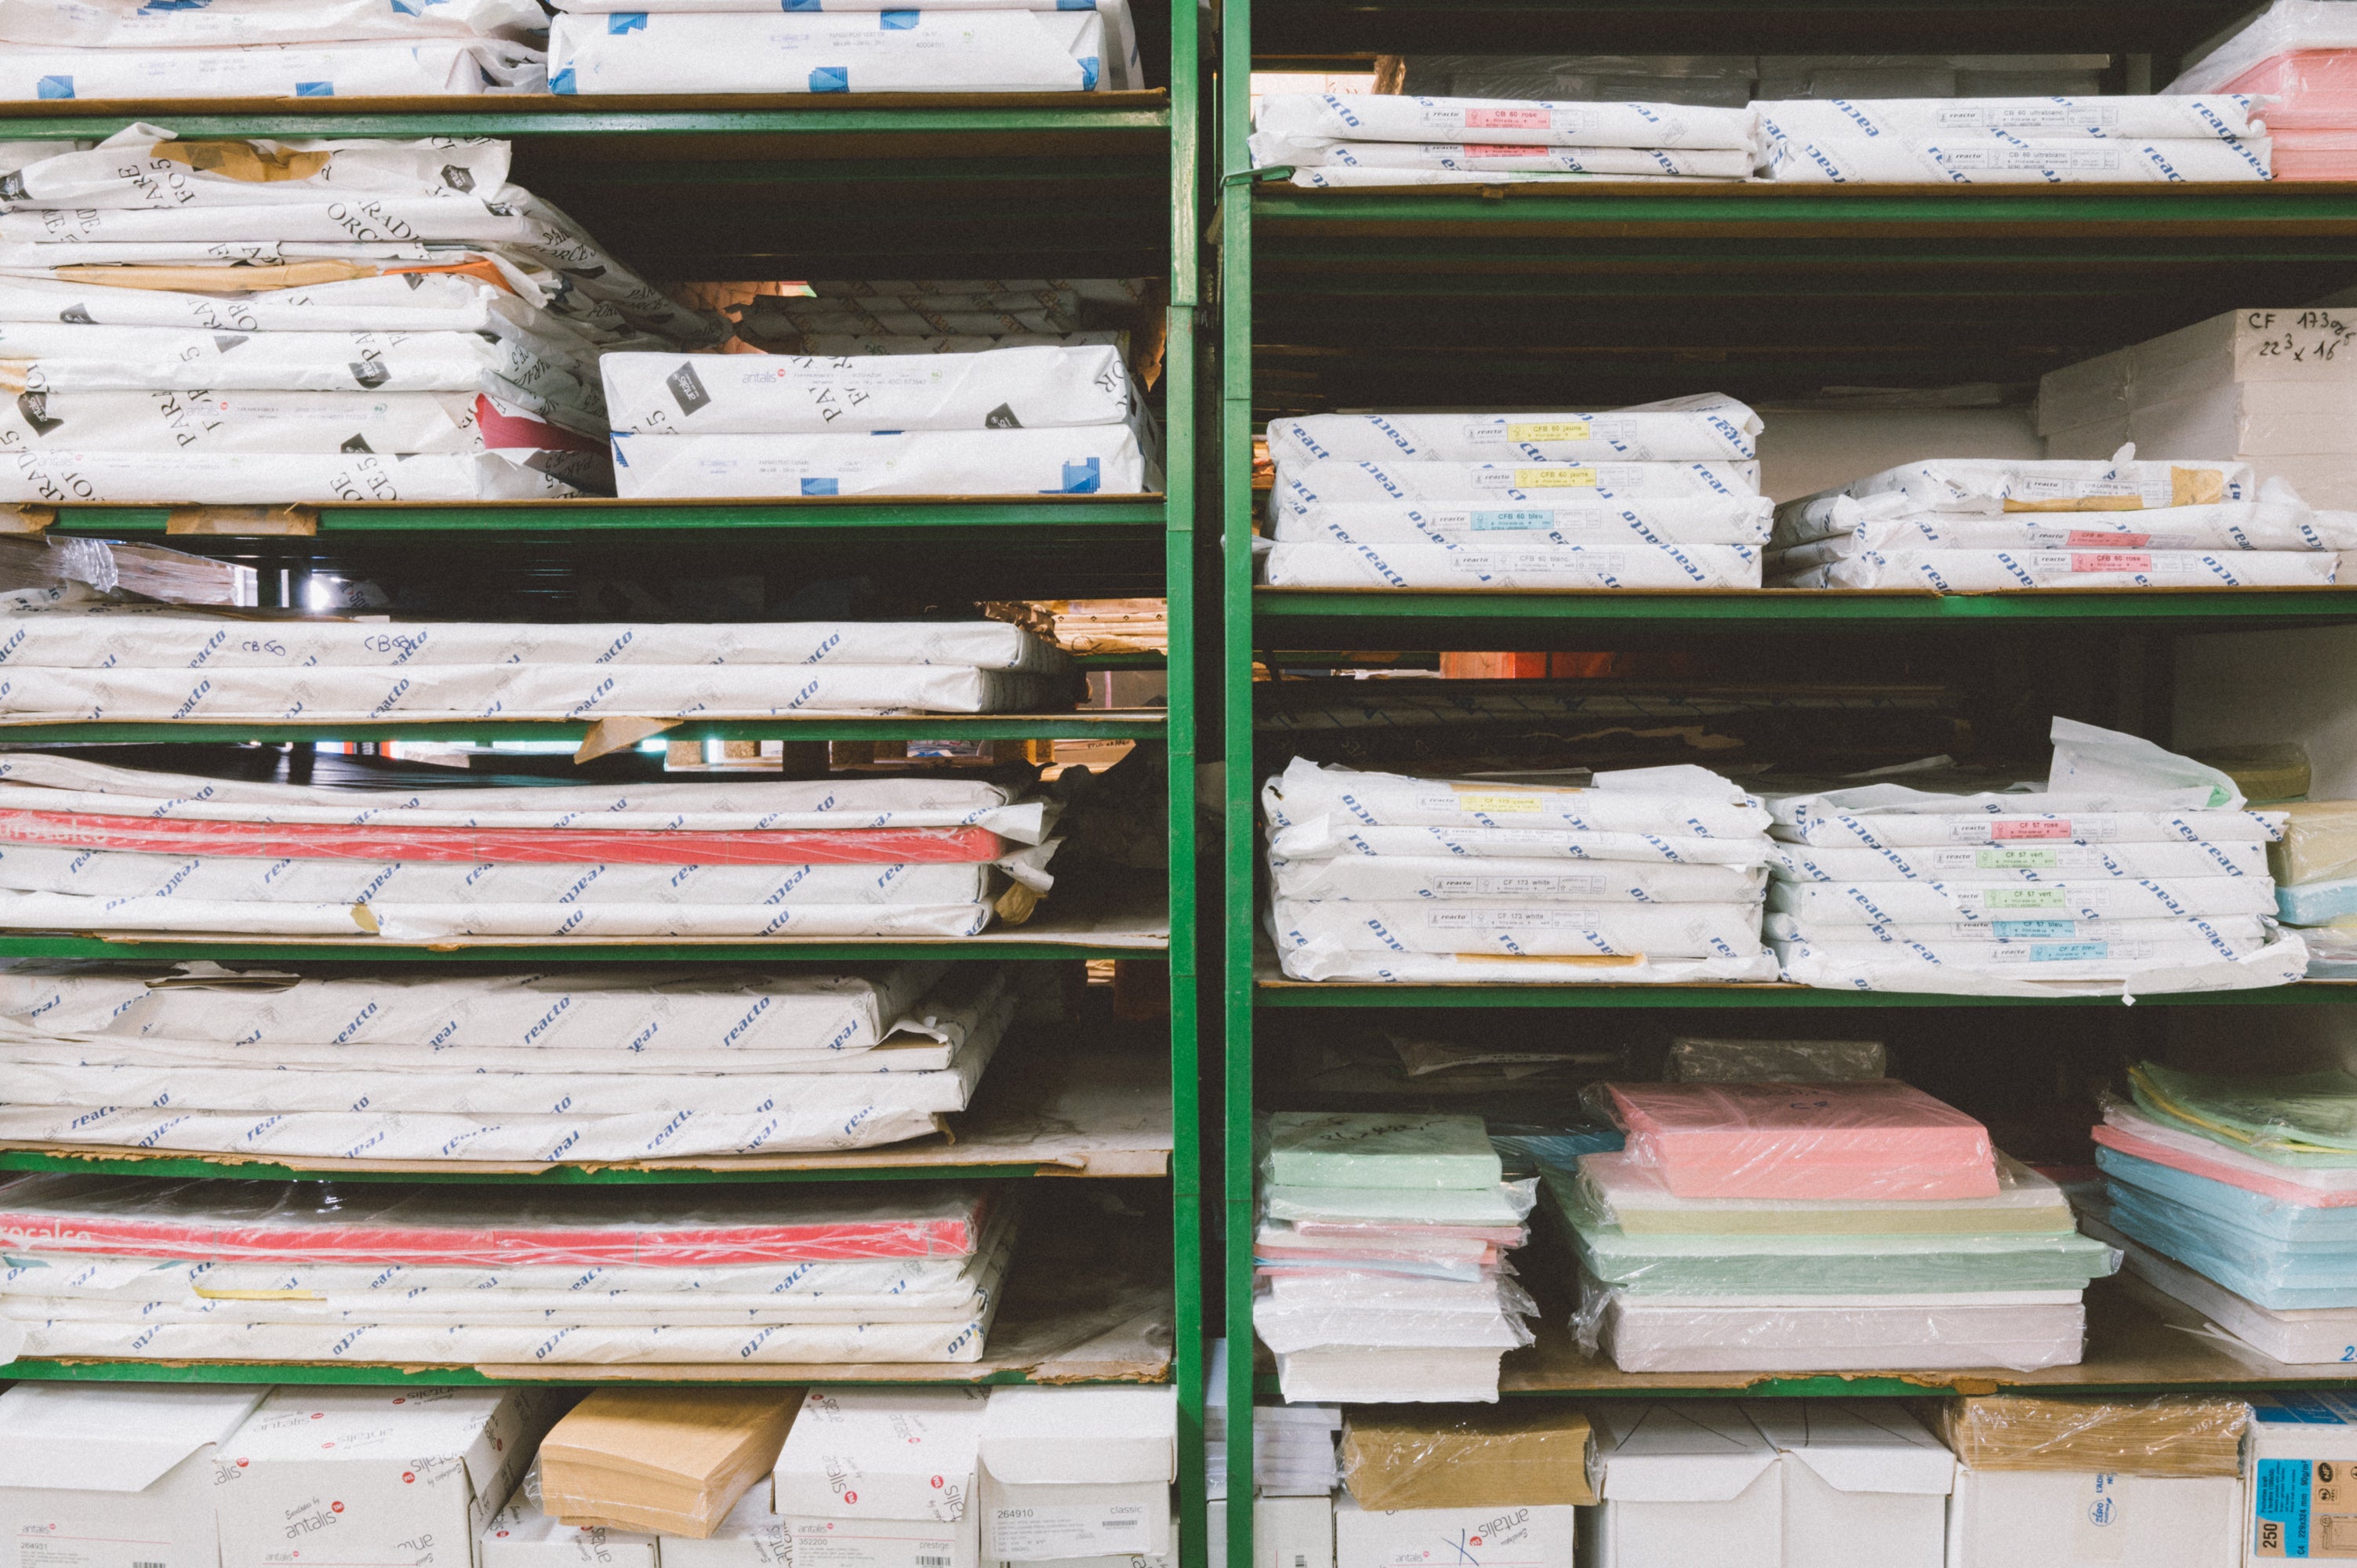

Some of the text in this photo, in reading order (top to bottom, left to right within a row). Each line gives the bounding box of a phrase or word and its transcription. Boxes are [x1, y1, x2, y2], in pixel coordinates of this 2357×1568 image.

[2248, 313, 2276, 330] CF
[743, 372, 777, 384] antalis
[677, 374, 696, 401] antalis
[523, 996, 570, 1046] reacto
[723, 996, 770, 1047] reacto
[2301, 1494, 2307, 1507] mm
[997, 1509, 1033, 1519] 264910
[1110, 1504, 1142, 1515] classic
[2093, 1501, 2104, 1523] ZÉRO
[285, 1511, 337, 1539] antalis
[798, 1523, 826, 1534] antalis
[1477, 1508, 1530, 1538] antalis
[22, 1524, 49, 1535] antalis
[2263, 1523, 2277, 1548] 250
[919, 1541, 950, 1552] prestige
[2297, 1545, 2305, 1555] C4
[265, 1553, 293, 1562] antalis
[1396, 1552, 1423, 1563] antalis
